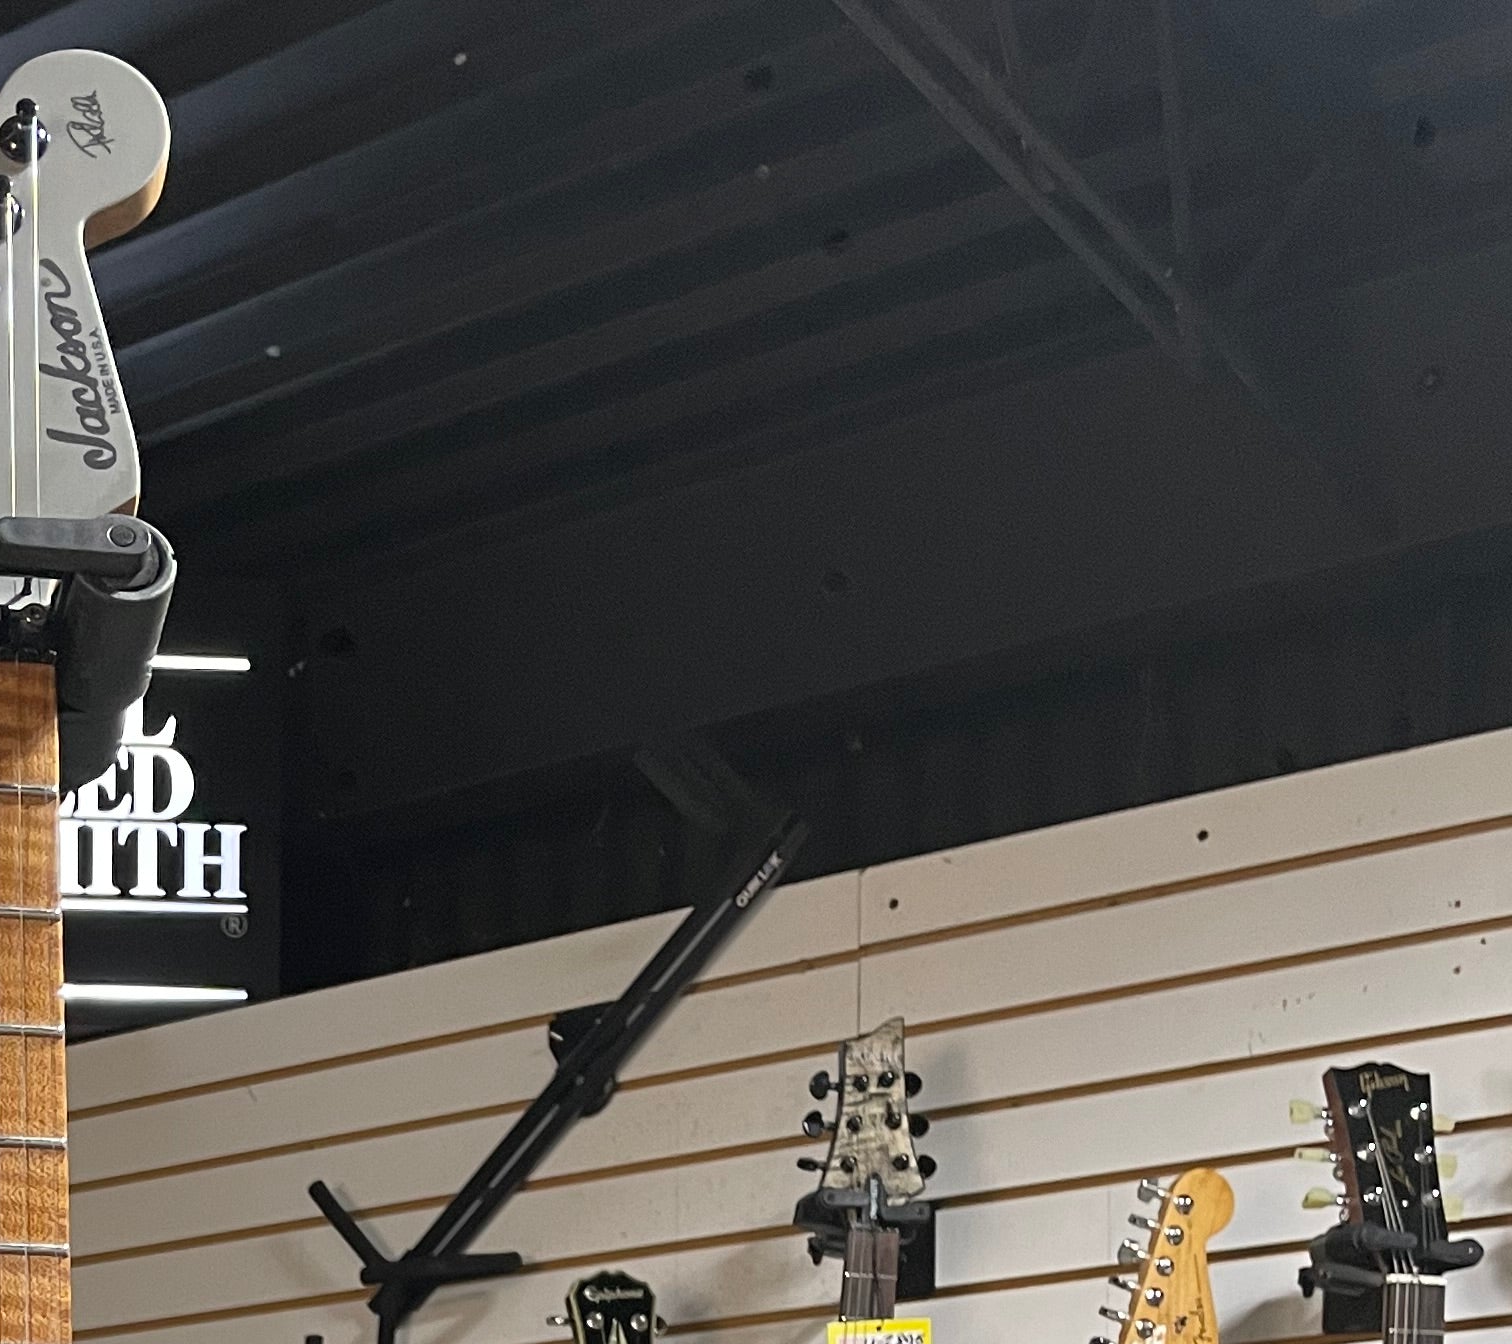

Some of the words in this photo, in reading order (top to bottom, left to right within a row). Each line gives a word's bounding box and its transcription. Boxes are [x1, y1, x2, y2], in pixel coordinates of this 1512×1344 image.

[39, 258, 117, 470] Jackson
[102, 378, 121, 415] MADE
[59, 745, 195, 821] ED
[60, 819, 248, 899] ITH
